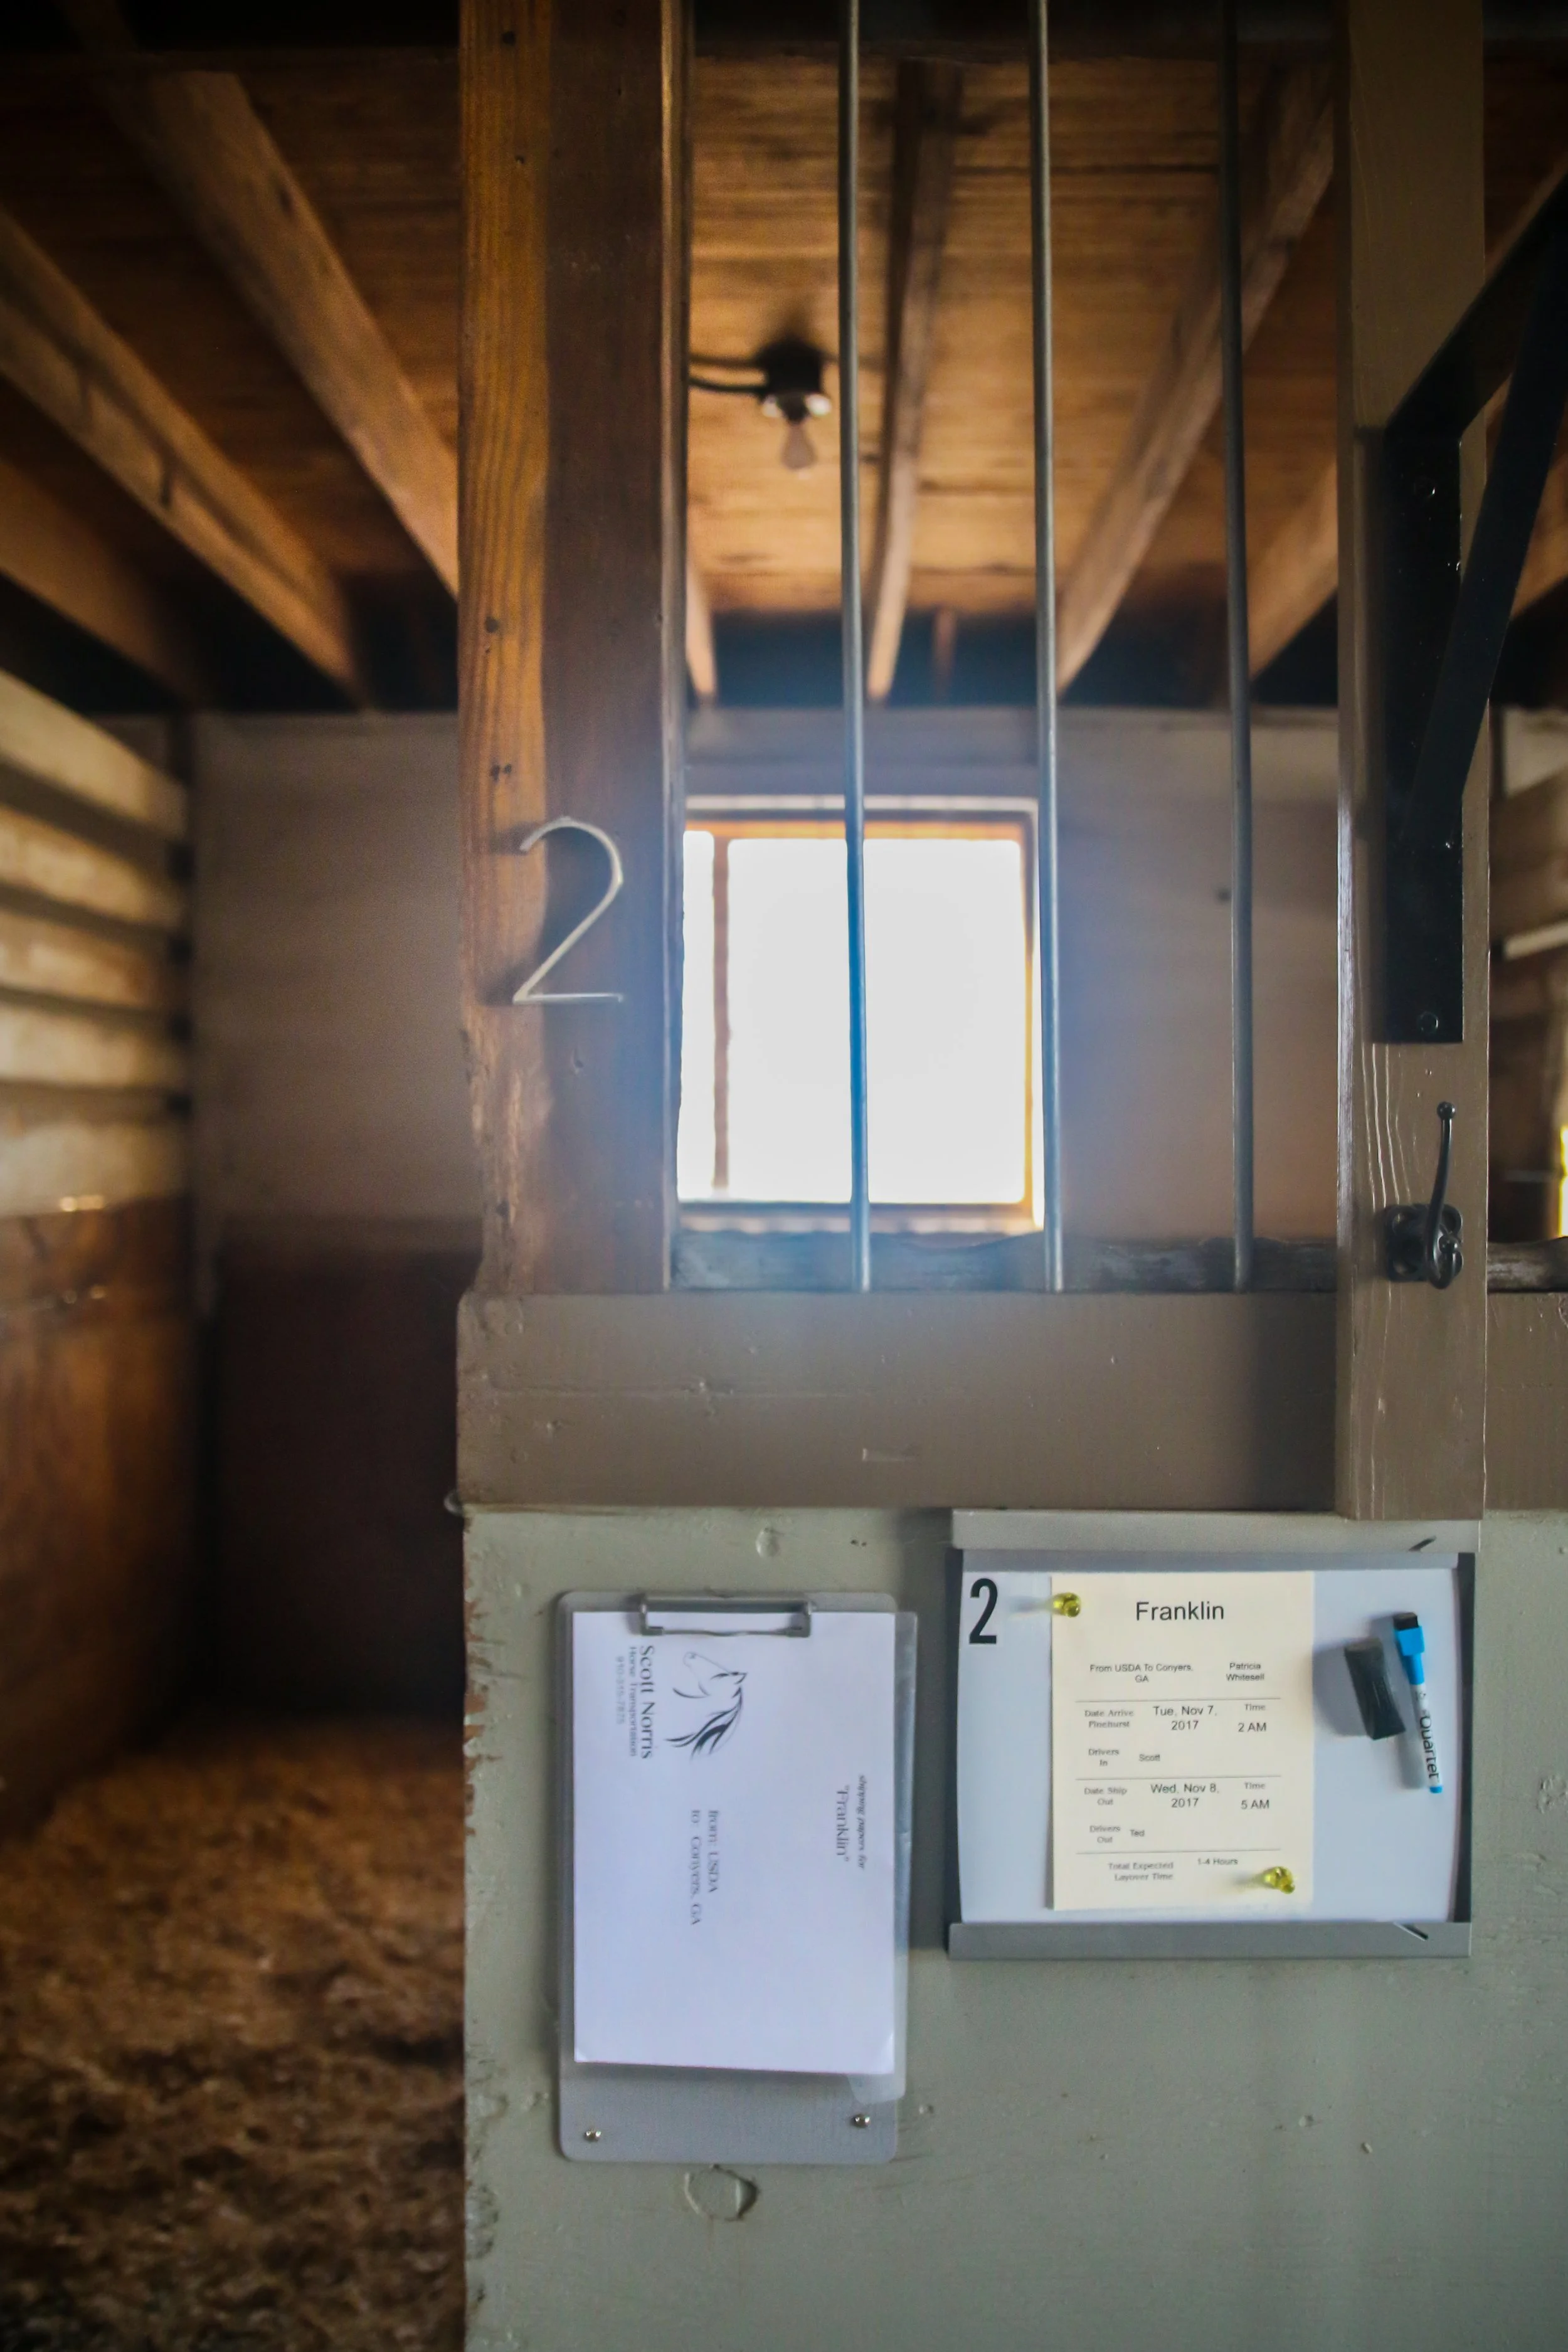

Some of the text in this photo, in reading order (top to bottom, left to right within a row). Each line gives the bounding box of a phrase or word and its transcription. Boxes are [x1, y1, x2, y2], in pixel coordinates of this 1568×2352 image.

[513, 816, 623, 1004] 2
[968, 1577, 998, 1644] 2
[1136, 1601, 1224, 1621] Franklin
[1089, 1664, 1112, 1673] From
[1115, 1663, 1141, 1673] USDA
[1144, 1663, 1153, 1673] To
[1229, 1661, 1261, 1670] Patricia
[1135, 1675, 1149, 1683] GA
[1226, 1673, 1265, 1682] Whitesell
[628, 1646, 638, 1757] Horse Transportation
[639, 1645, 659, 1759] Scott Norris
[1084, 1708, 1134, 1717] Date Arrive
[1182, 1705, 1204, 1716] Nov
[1244, 1703, 1266, 1712] Time
[1088, 1720, 1130, 1729] Pinehurst
[1171, 1720, 1199, 1731] 2017
[1238, 1722, 1267, 1732] 2 AM
[1088, 1747, 1120, 1756] Drivers
[1420, 1715, 1441, 1782] Quartet
[1139, 1753, 1161, 1762] Scott
[1099, 1759, 1108, 1767] In
[1184, 1783, 1206, 1794] Nov
[1244, 1781, 1266, 1790] Time
[1084, 1786, 1128, 1796] Date Ship
[1098, 1798, 1114, 1806] Out
[1171, 1797, 1199, 1808] 2017
[1241, 1799, 1270, 1810] 5 AM
[836, 1785, 850, 1862] "Franklin"
[856, 1775, 868, 1870] shipping papers for
[1089, 1825, 1121, 1833] Drivers
[1130, 1828, 1145, 1838] Ted
[1097, 1835, 1113, 1844] Out
[1108, 1861, 1173, 1871] Total Expected
[1197, 1857, 1239, 1866] 1-4 Hours
[707, 1851, 721, 1893] USDA
[1115, 1872, 1173, 1882] Layover Time
[691, 1904, 703, 1925] GA
